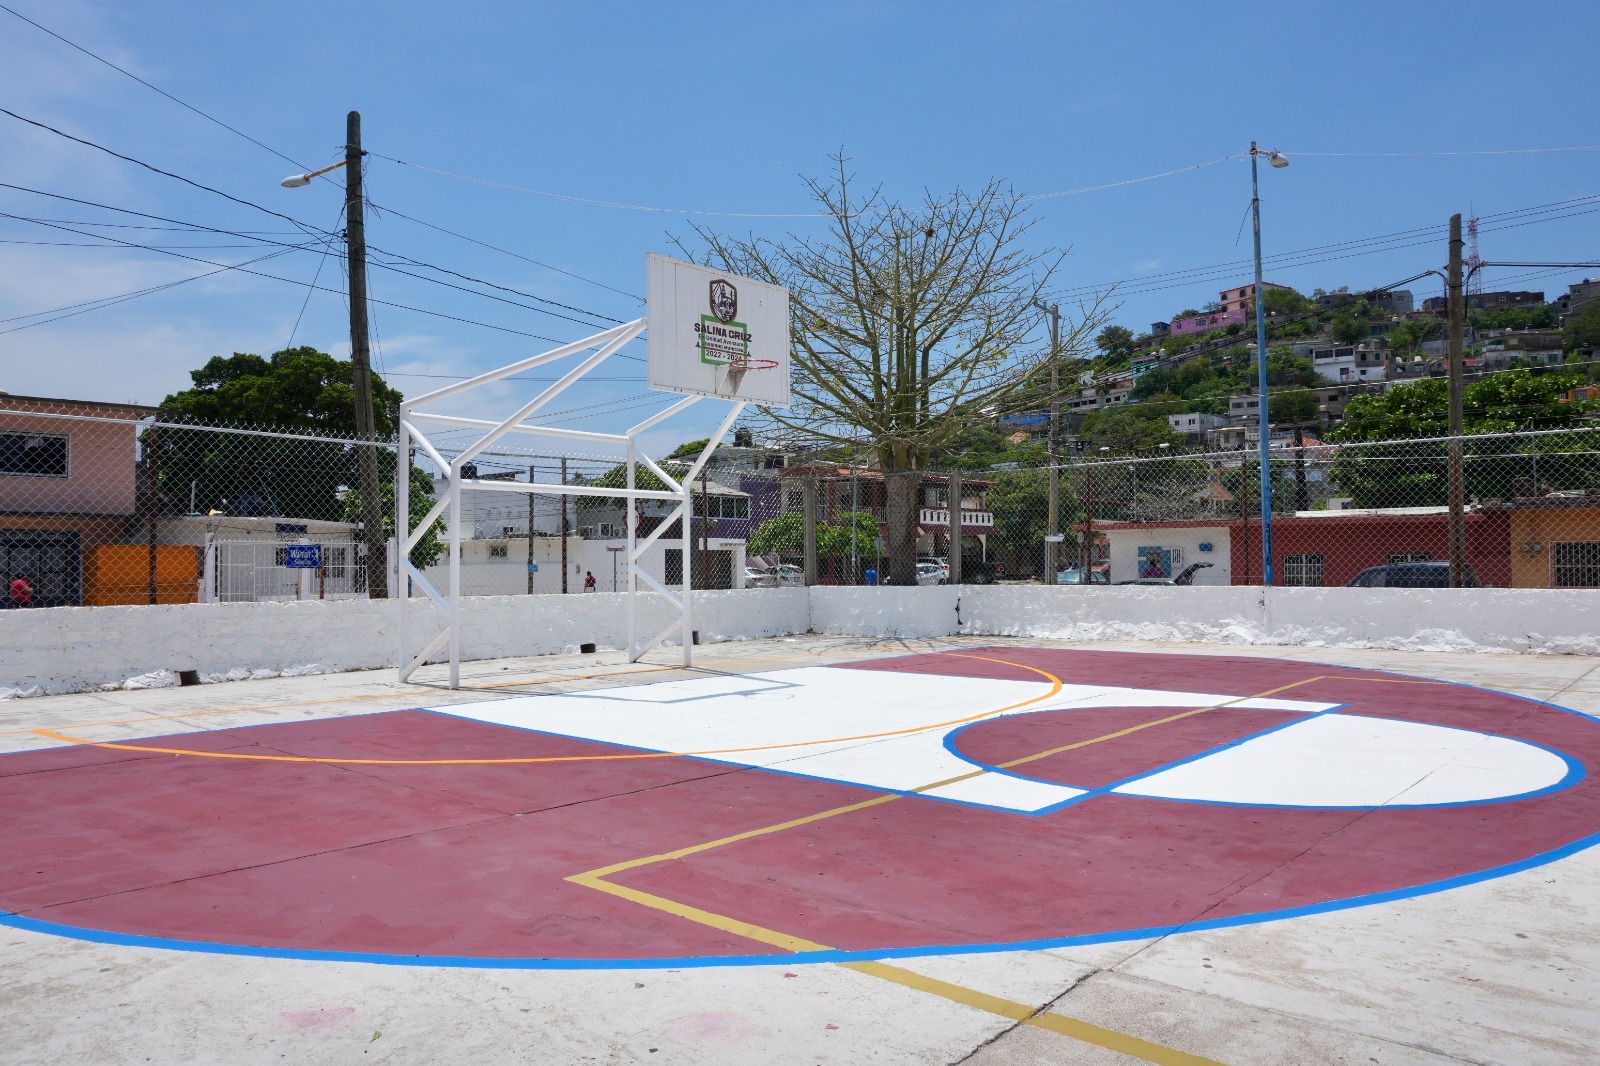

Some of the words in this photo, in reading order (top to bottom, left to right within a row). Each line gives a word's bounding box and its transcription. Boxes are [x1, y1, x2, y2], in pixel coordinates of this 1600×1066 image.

[694, 323, 727, 338] SALINA
[729, 330, 752, 342] CRUZ
[706, 335, 722, 343] Unidad
[706, 350, 722, 358] 2022
